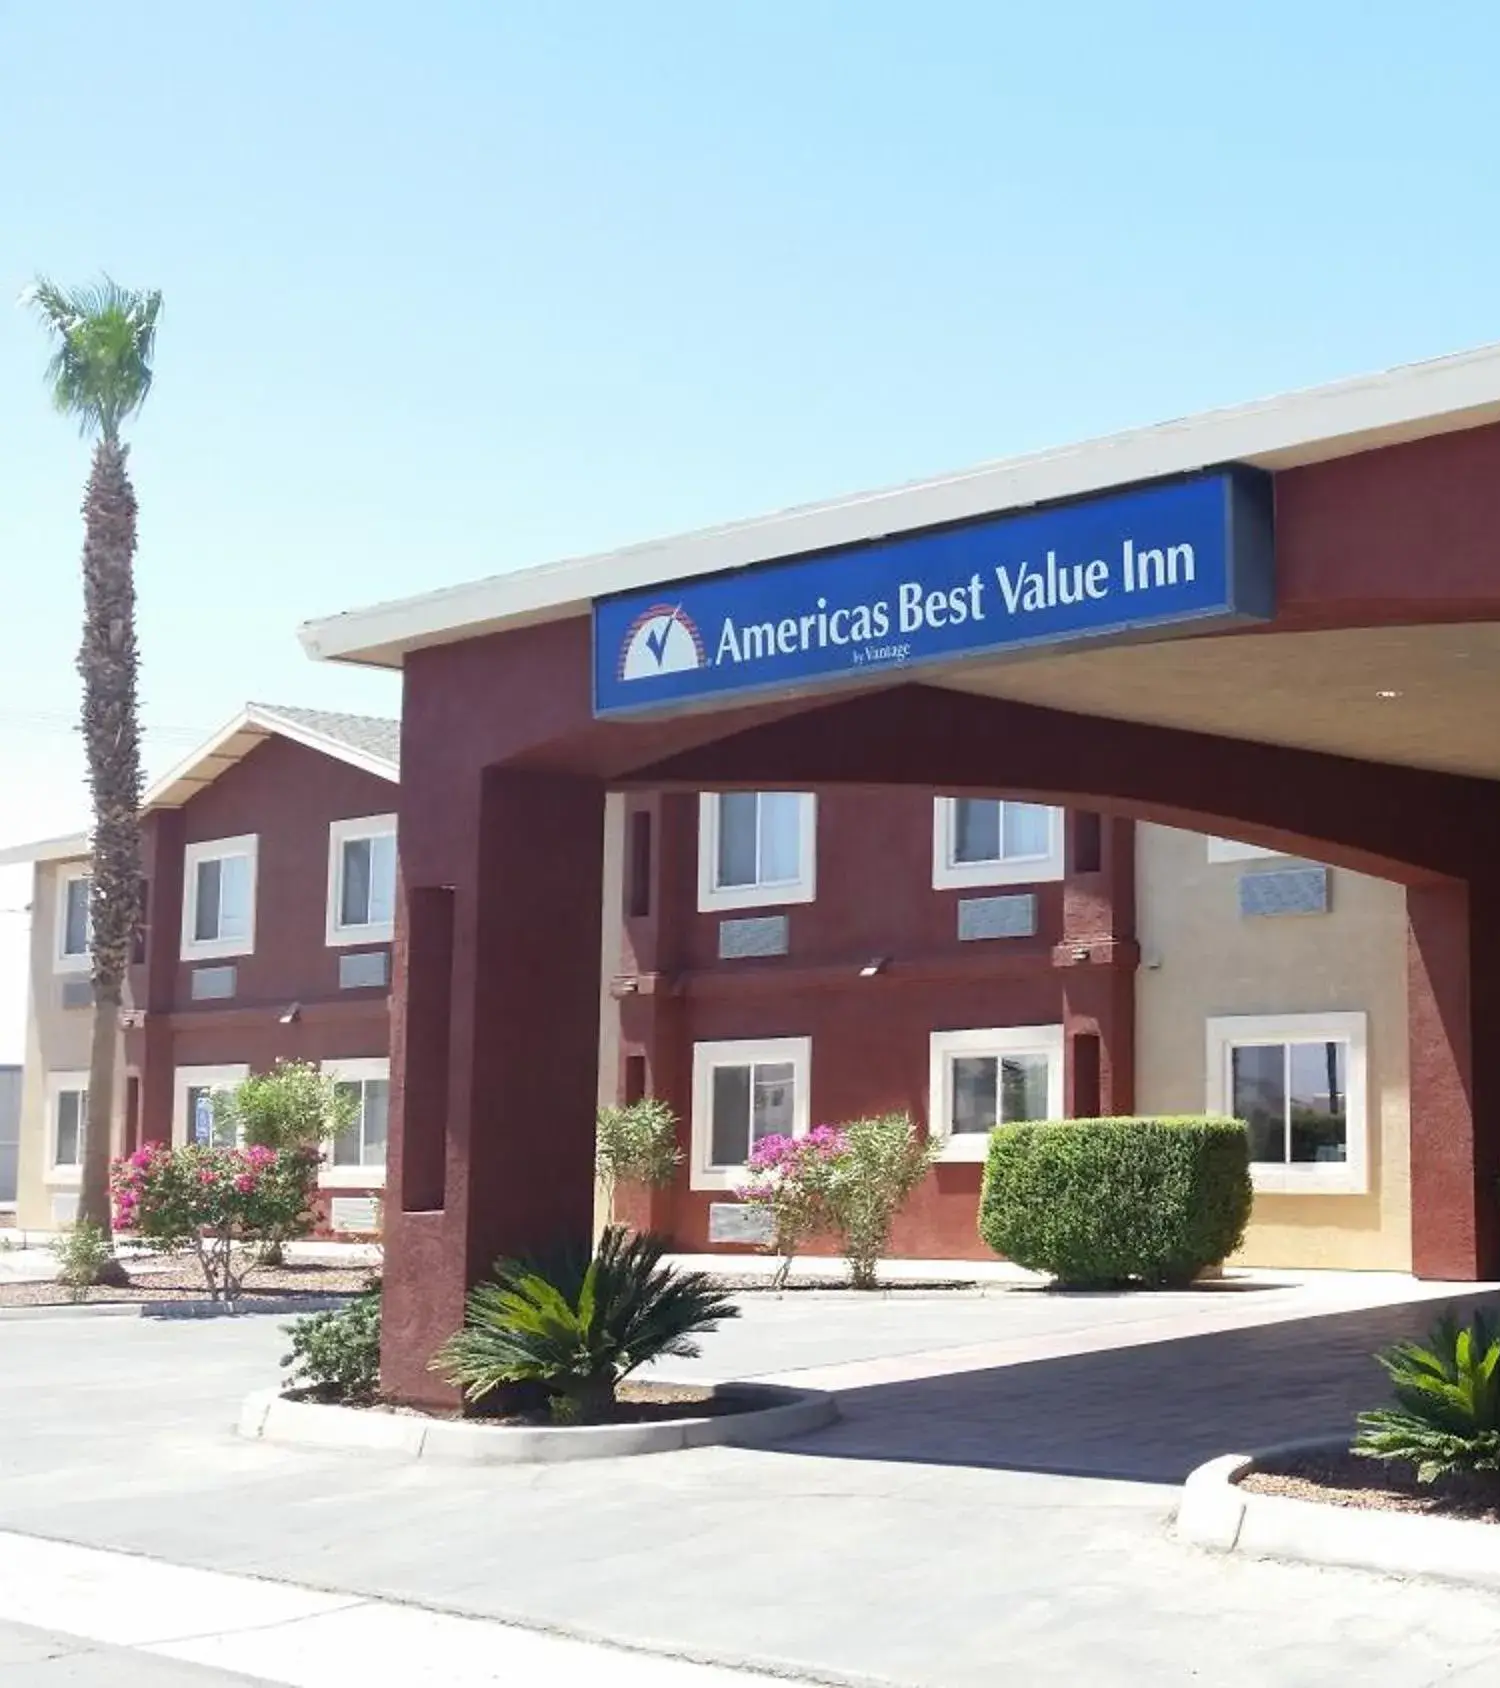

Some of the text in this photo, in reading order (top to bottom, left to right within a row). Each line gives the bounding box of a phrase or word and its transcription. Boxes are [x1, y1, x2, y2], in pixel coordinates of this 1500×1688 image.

[715, 540, 1195, 666] Americas Best Value Inn
[865, 644, 910, 662] Vantage
